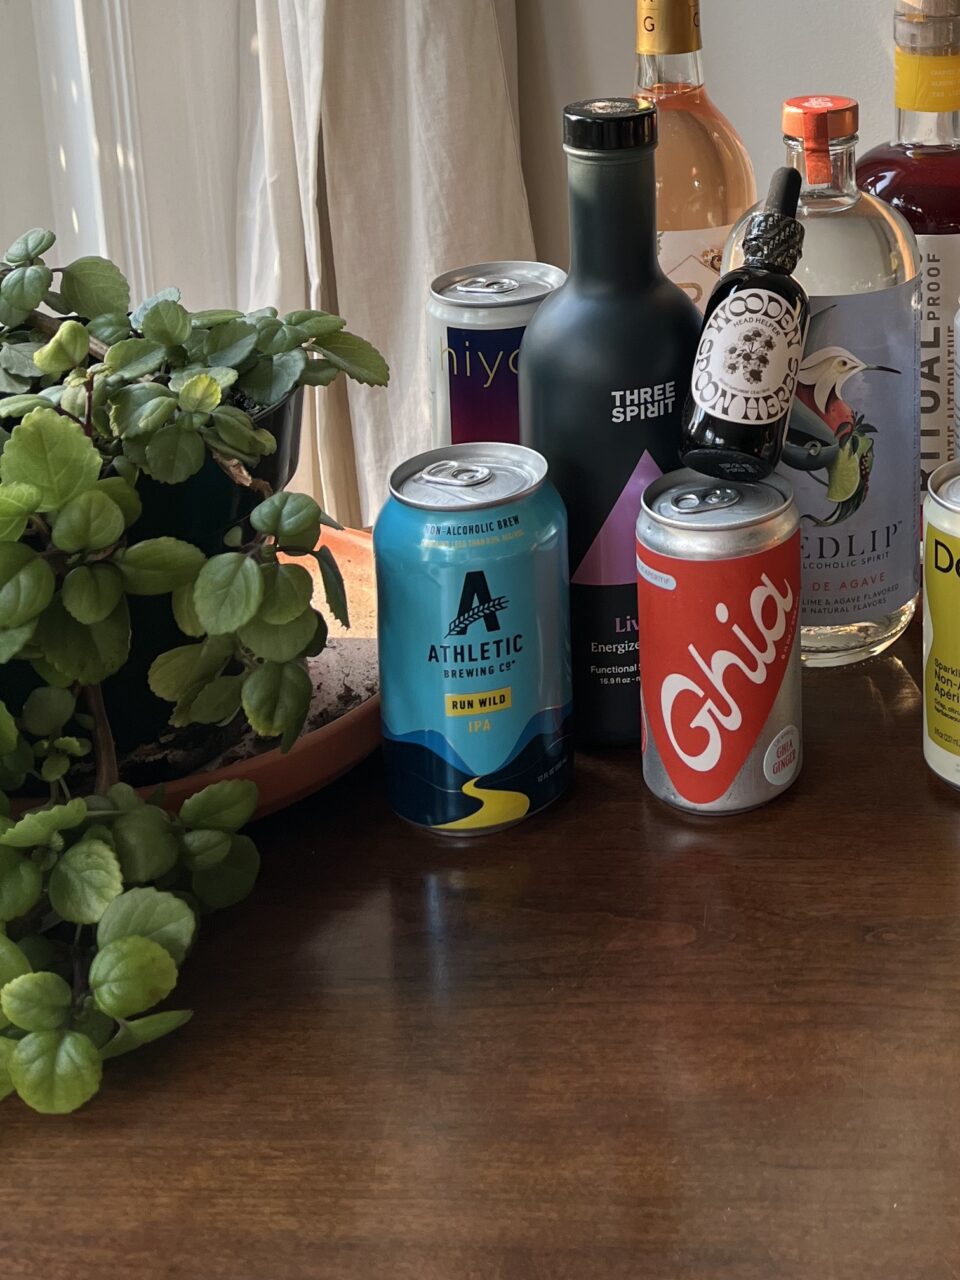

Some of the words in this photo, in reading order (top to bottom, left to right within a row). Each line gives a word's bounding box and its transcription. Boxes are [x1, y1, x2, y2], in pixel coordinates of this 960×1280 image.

[643, 16, 655, 32] G
[927, 252, 941, 321] PROOF
[707, 292, 801, 349] WOODEN
[733, 317, 754, 328] HEAD
[755, 318, 781, 337] HELPER
[694, 337, 739, 417] SPOON
[611, 381, 676, 407] THREE
[740, 356, 799, 421] HERBS
[611, 397, 676, 424] SPIRIT
[426, 521, 494, 536] NON-ALCOHOLIC
[497, 515, 520, 530] BREW
[861, 551, 890, 566] SPIRIT
[812, 581, 830, 592] DE
[840, 571, 886, 590] AGAVE
[833, 597, 860, 605] AGAVE
[863, 583, 900, 600] FLAVORED
[810, 606, 850, 615] NATURAL
[853, 597, 887, 612] FLAVORS
[428, 634, 524, 664] ATHLETIC
[444, 665, 494, 679] BREWING
[590, 663, 637, 674] Functional
[660, 572, 794, 773] Ghia
[600, 677, 615, 685] 16.9
[452, 699, 474, 710] RUN
[478, 694, 506, 708] WILD
[468, 719, 492, 734] IPA
[776, 739, 794, 759] GHIA
[772, 749, 796, 775] GINGER
